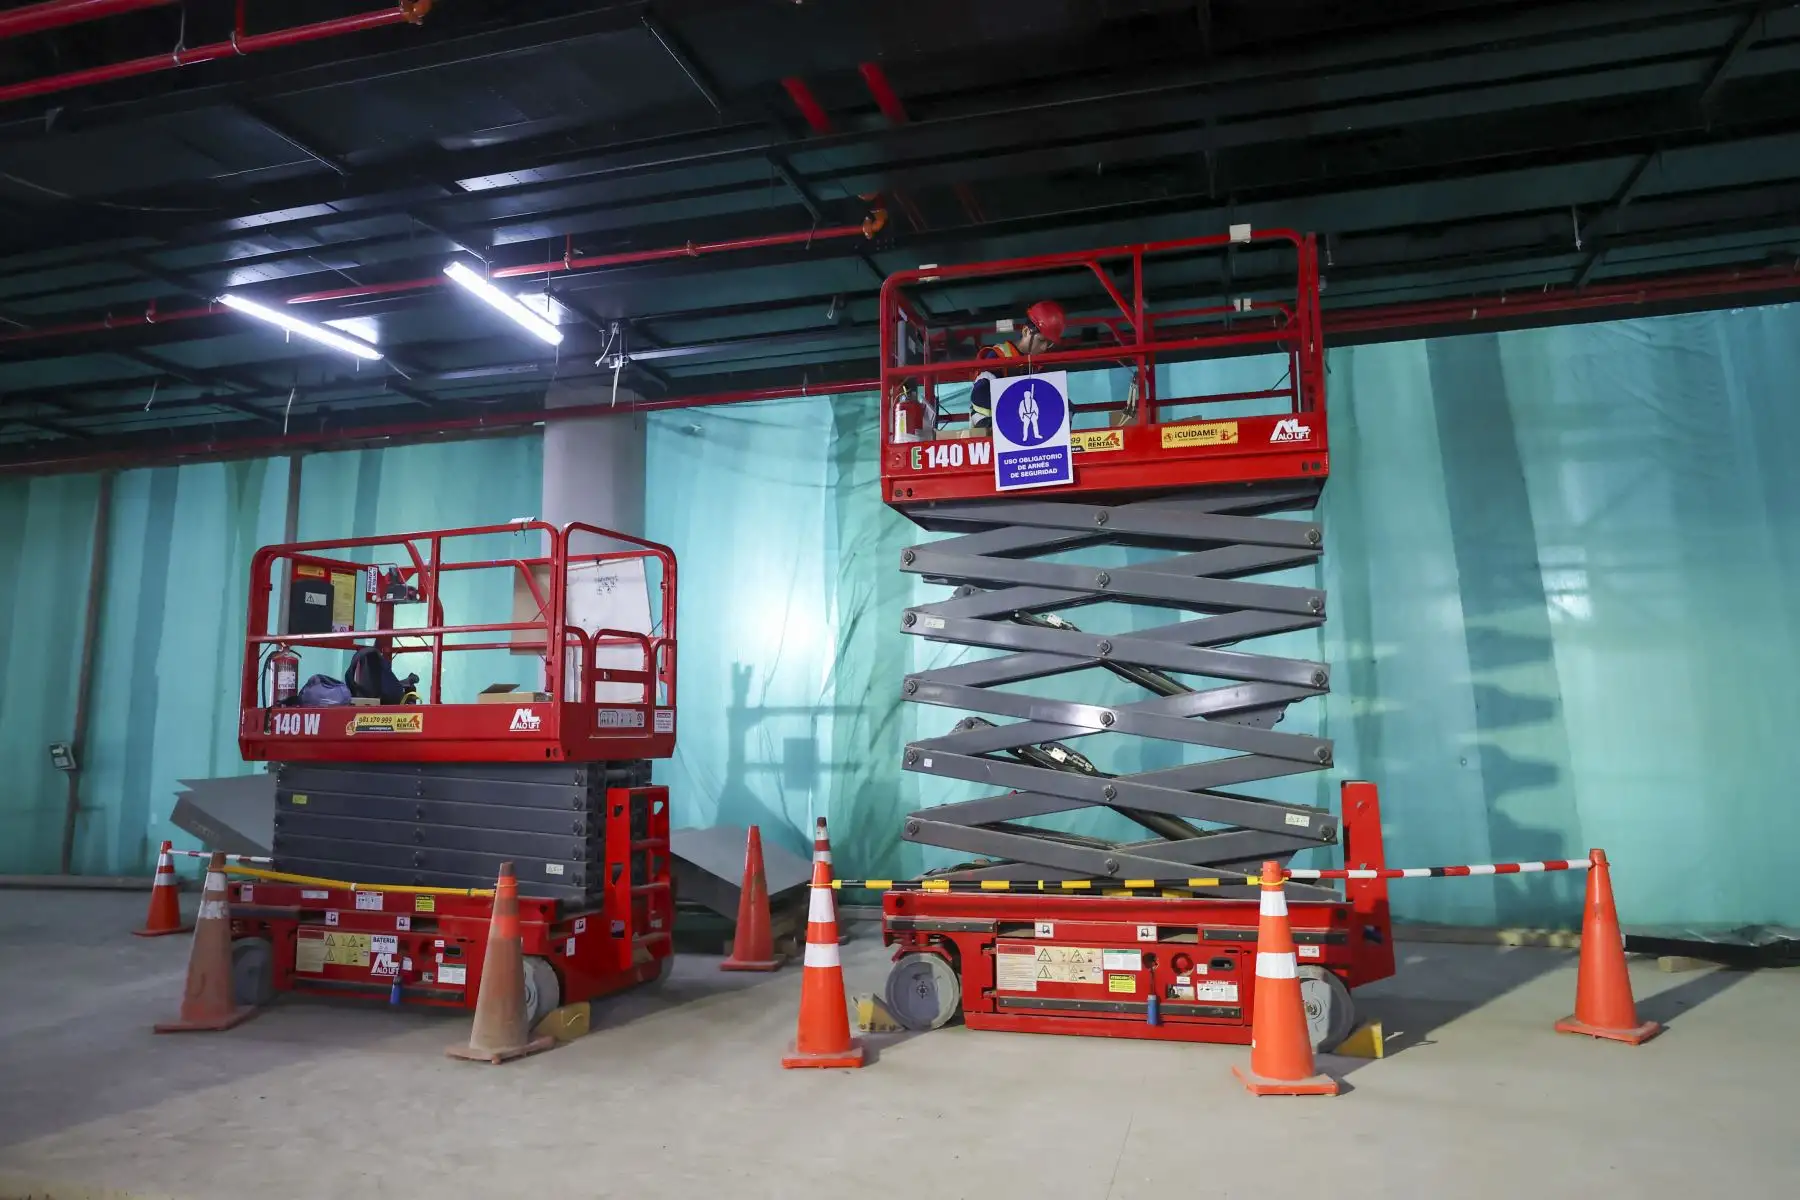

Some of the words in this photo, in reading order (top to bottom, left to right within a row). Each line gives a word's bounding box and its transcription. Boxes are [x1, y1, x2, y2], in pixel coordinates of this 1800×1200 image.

[1279, 433, 1293, 441] ALO
[911, 446, 922, 470] E
[925, 443, 963, 468] 140
[967, 441, 991, 465] W
[1018, 453, 1063, 464] OBLIGATORIO
[1028, 461, 1050, 470] ARNÉS
[1020, 468, 1058, 477] SEGURIDAD
[274, 713, 300, 735] 140
[304, 713, 321, 735] W
[372, 936, 396, 944] BATERIA
